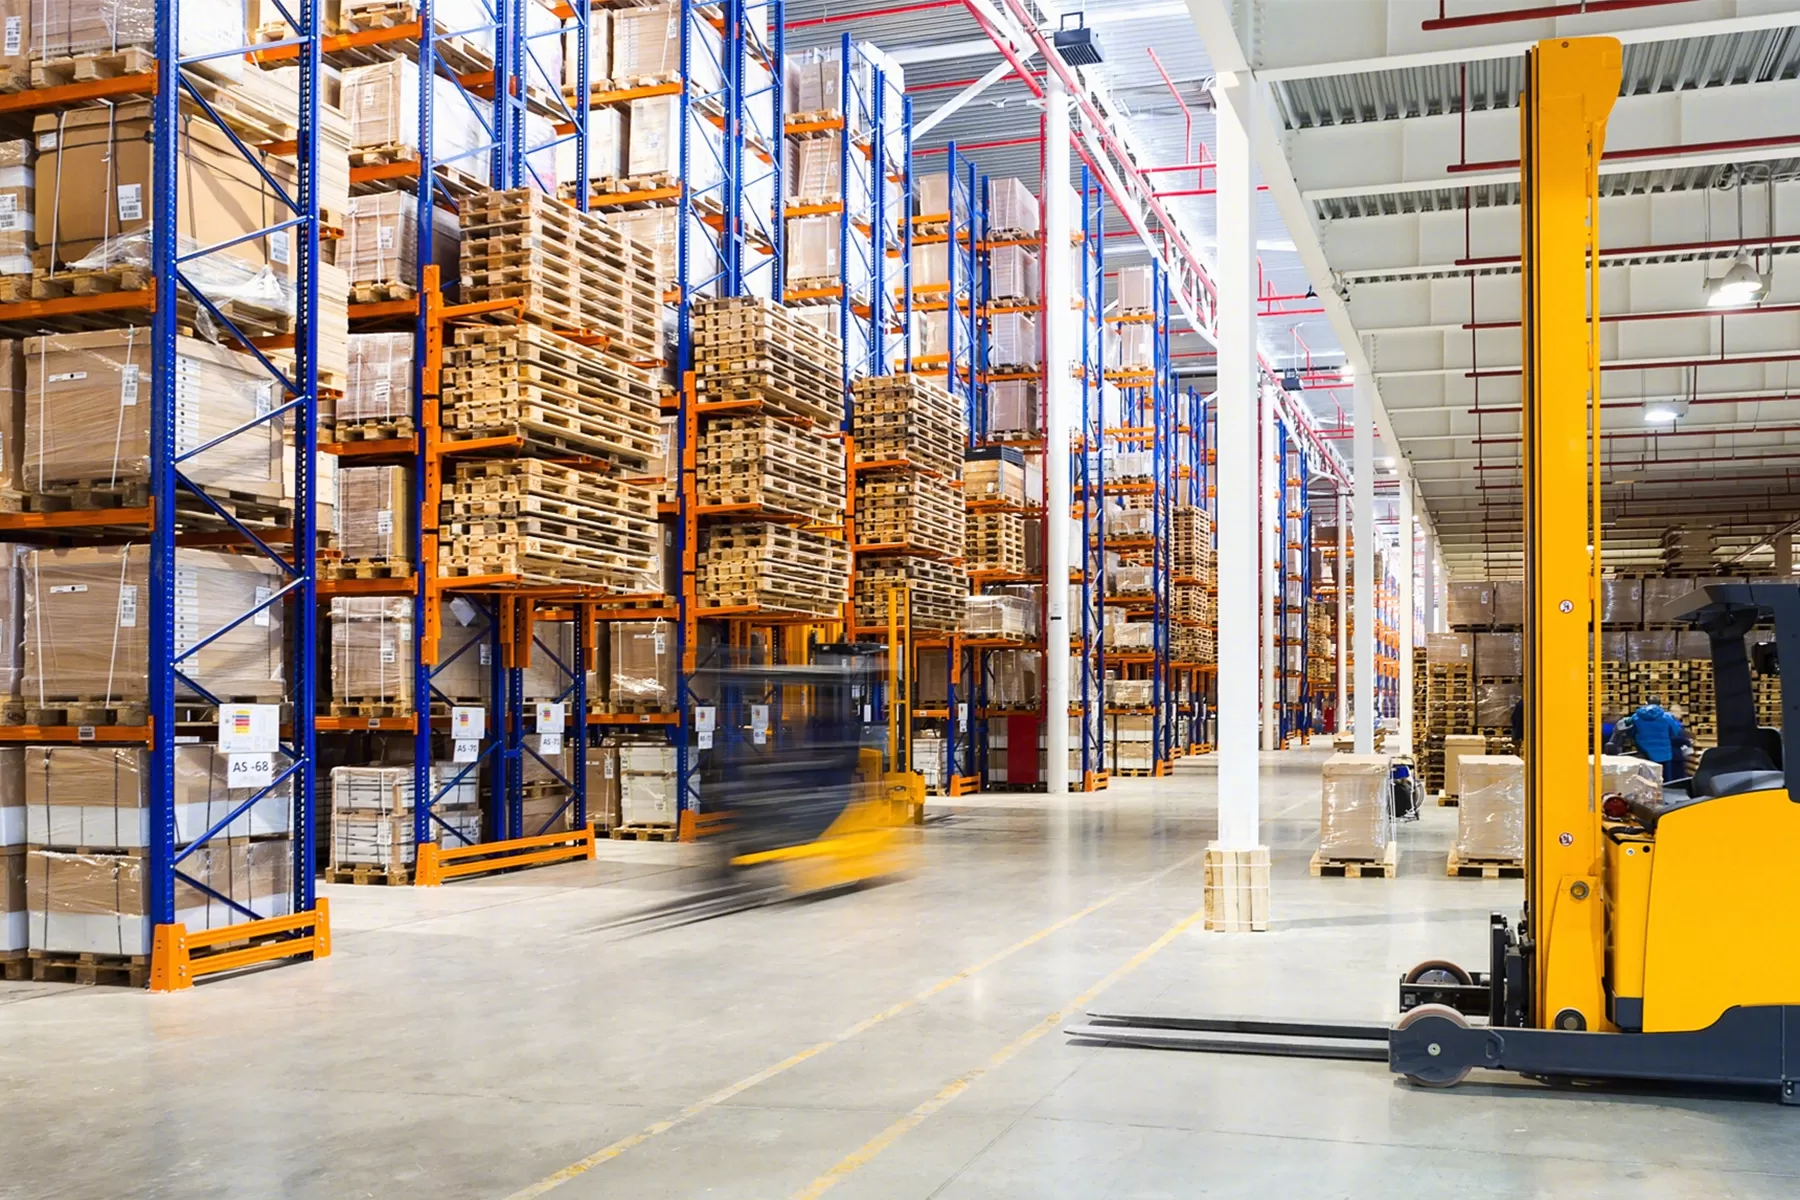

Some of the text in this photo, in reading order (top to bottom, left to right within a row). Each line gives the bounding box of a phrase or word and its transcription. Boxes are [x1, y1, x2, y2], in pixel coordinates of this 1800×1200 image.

[457, 744, 467, 752] AS
[232, 761, 269, 772] AS -68
